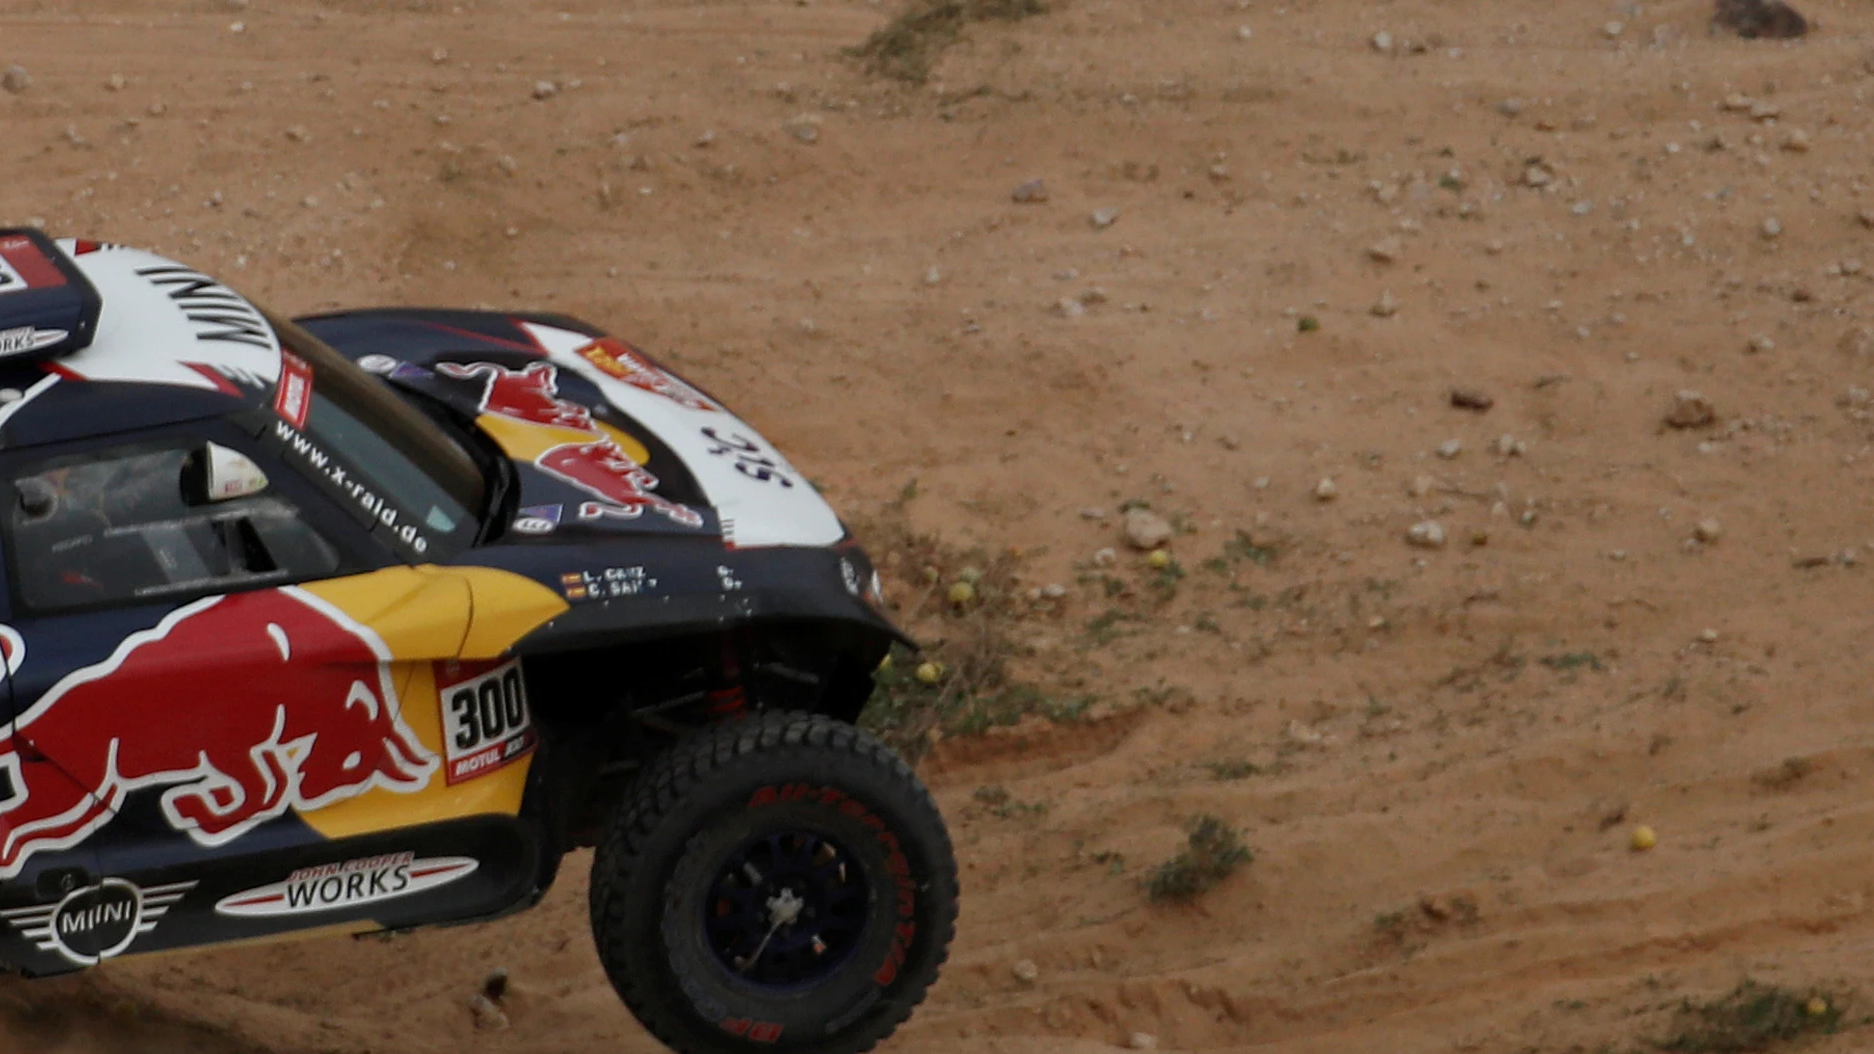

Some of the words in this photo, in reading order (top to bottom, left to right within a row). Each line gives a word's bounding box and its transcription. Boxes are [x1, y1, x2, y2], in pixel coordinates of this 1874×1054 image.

[276, 420, 427, 552] www.x-raid.de
[451, 667, 524, 749] 300
[455, 748, 502, 777] MOTUL
[288, 865, 409, 907] WORKS
